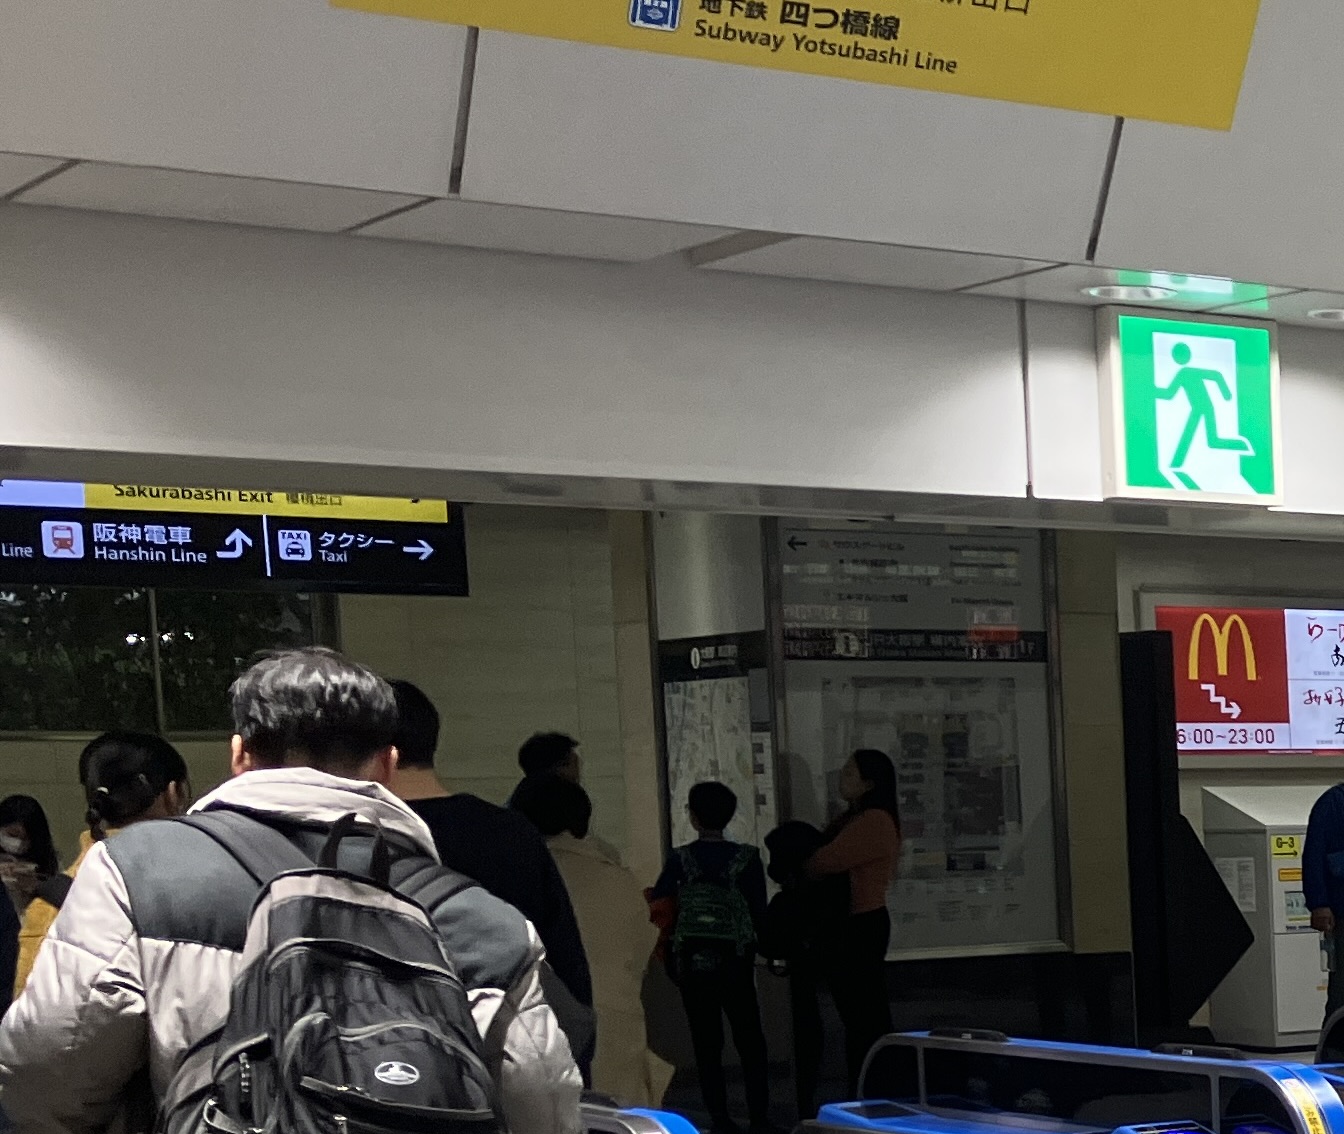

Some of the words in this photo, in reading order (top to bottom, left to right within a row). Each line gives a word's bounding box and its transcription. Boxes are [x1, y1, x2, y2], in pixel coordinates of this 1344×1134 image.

[779, 0, 901, 41] 四つ橋線
[694, 19, 785, 52] Subway
[792, 33, 910, 67] Yotsubashi
[913, 50, 958, 74] Line
[112, 483, 232, 503] Sakurabashi
[238, 490, 274, 504] Exit
[92, 522, 192, 546] 阪神電車
[280, 531, 308, 541] TAXI
[318, 532, 396, 549] タクシー
[1, 541, 33, 558] Line
[94, 545, 167, 562] Hanshin
[171, 547, 208, 564] Line
[318, 550, 348, 563] Taxi
[1275, 836, 1296, 849] G-3
